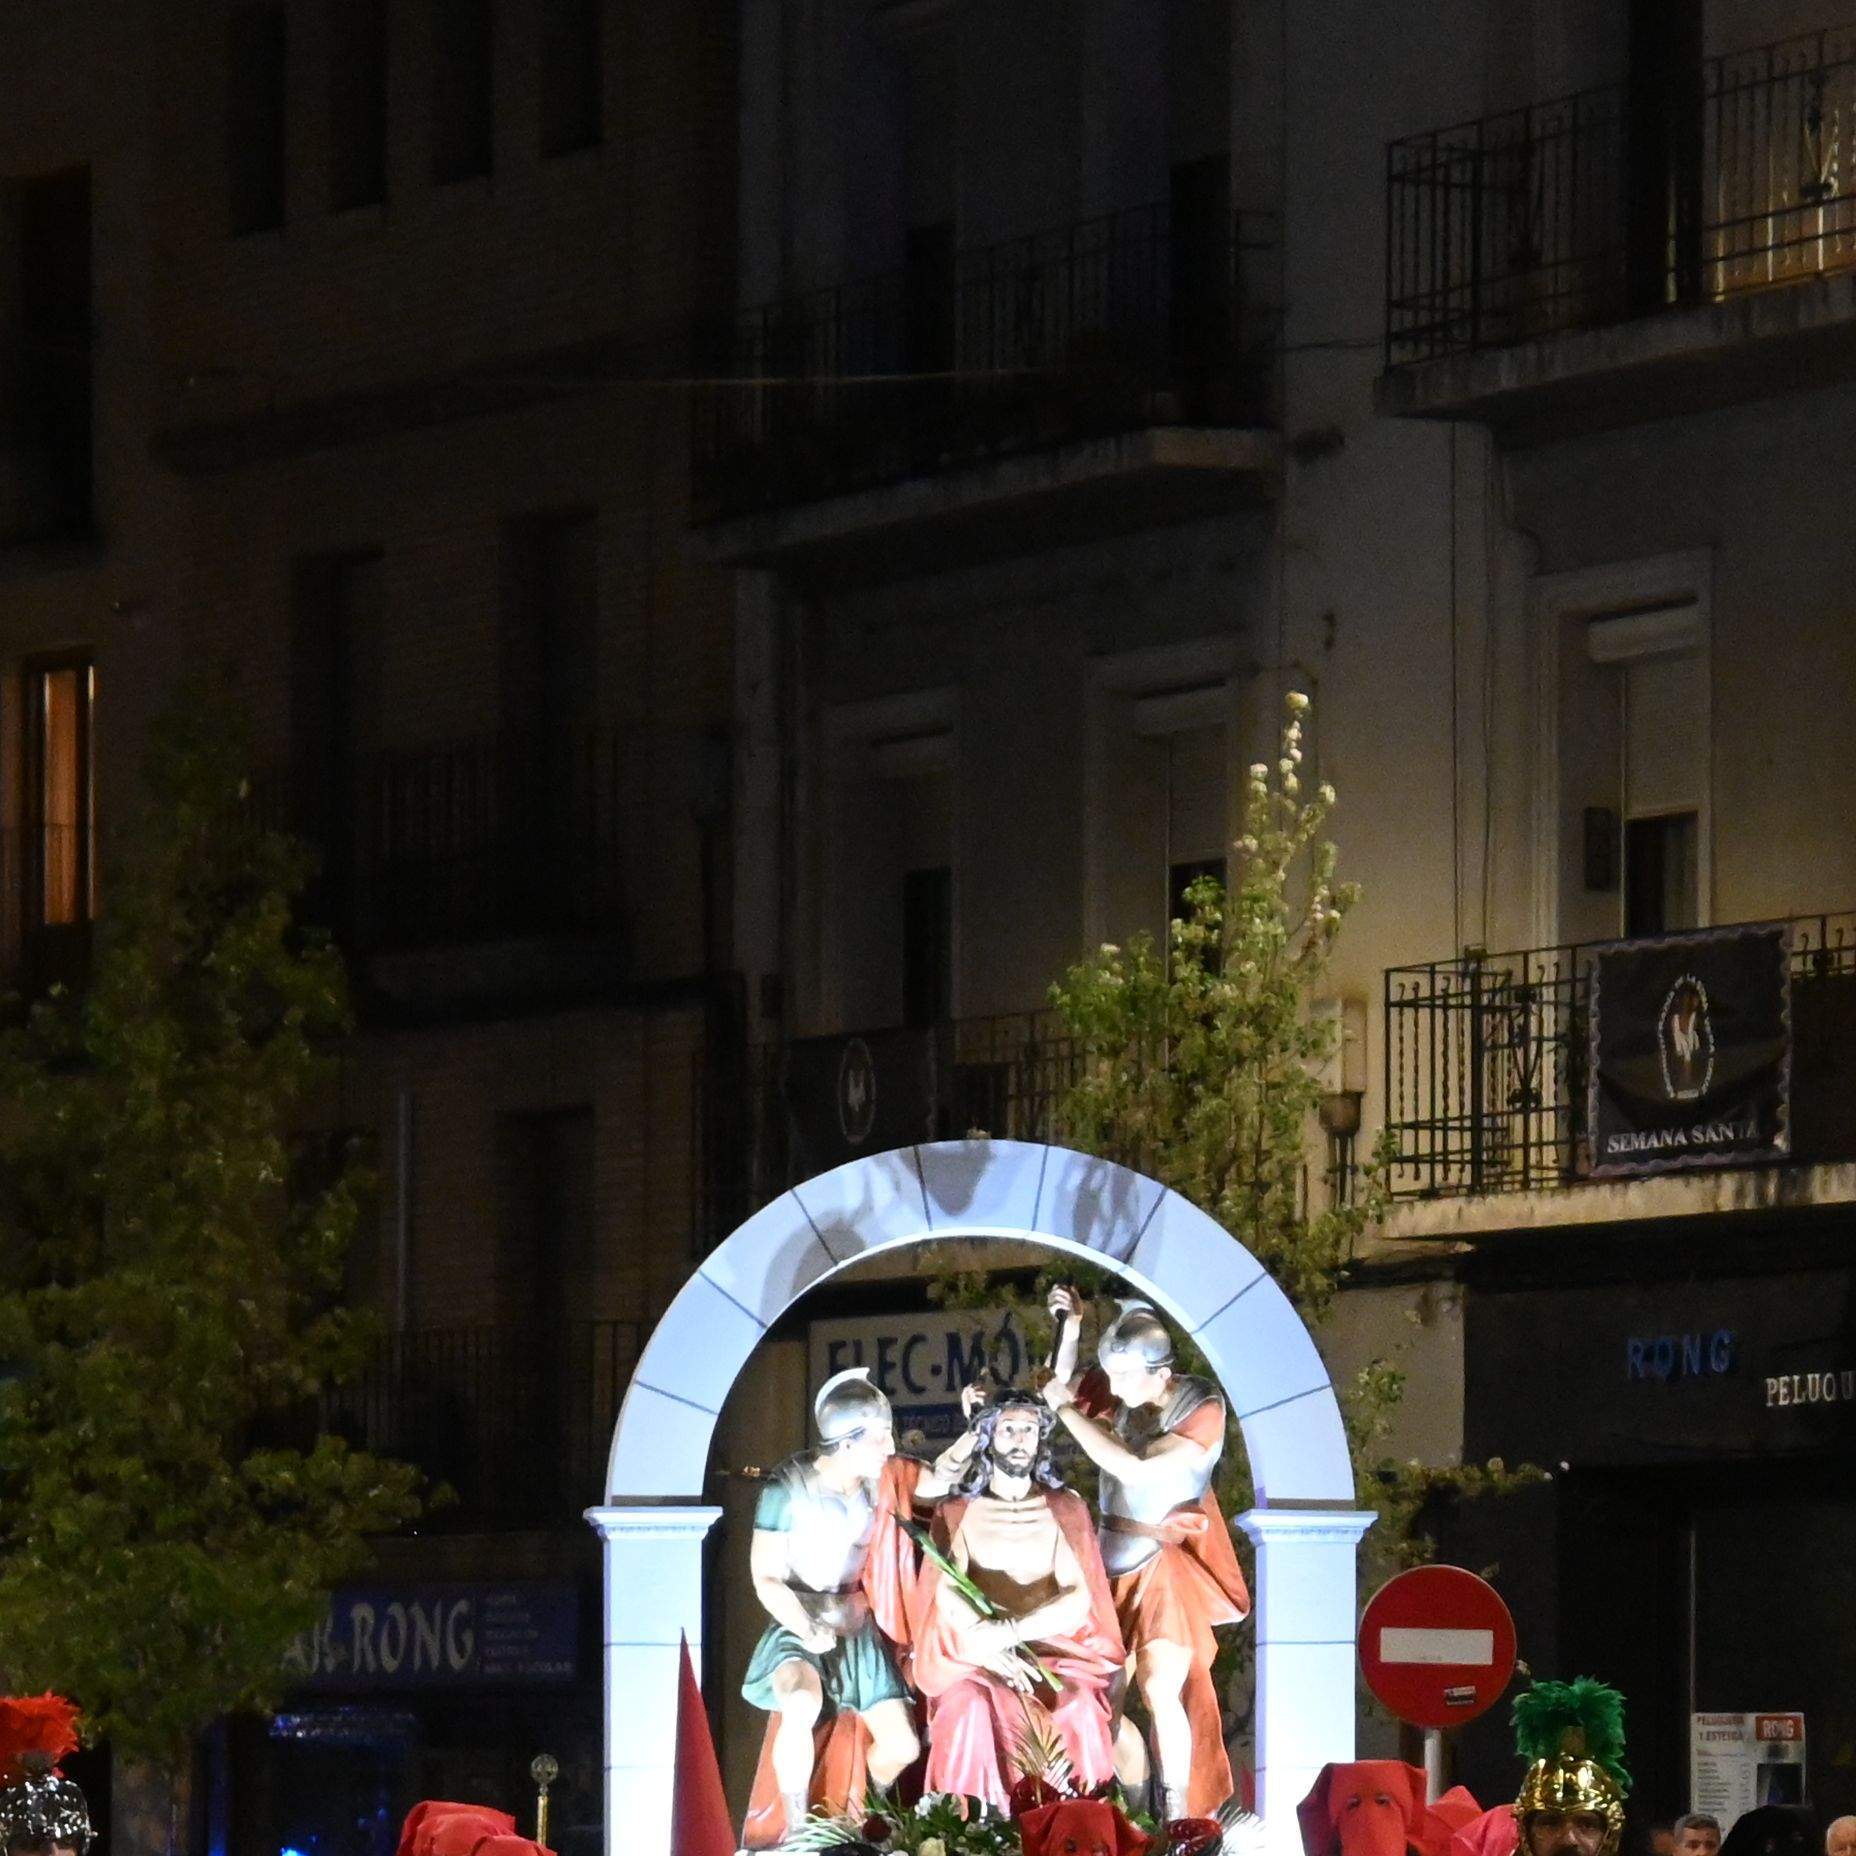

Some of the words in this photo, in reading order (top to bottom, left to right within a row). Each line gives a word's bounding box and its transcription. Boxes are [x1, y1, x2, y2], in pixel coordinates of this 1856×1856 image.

[1606, 1128, 1688, 1153] SEMANA
[1626, 1328, 1734, 1382] RONG
[350, 1599, 476, 1674] RONG
